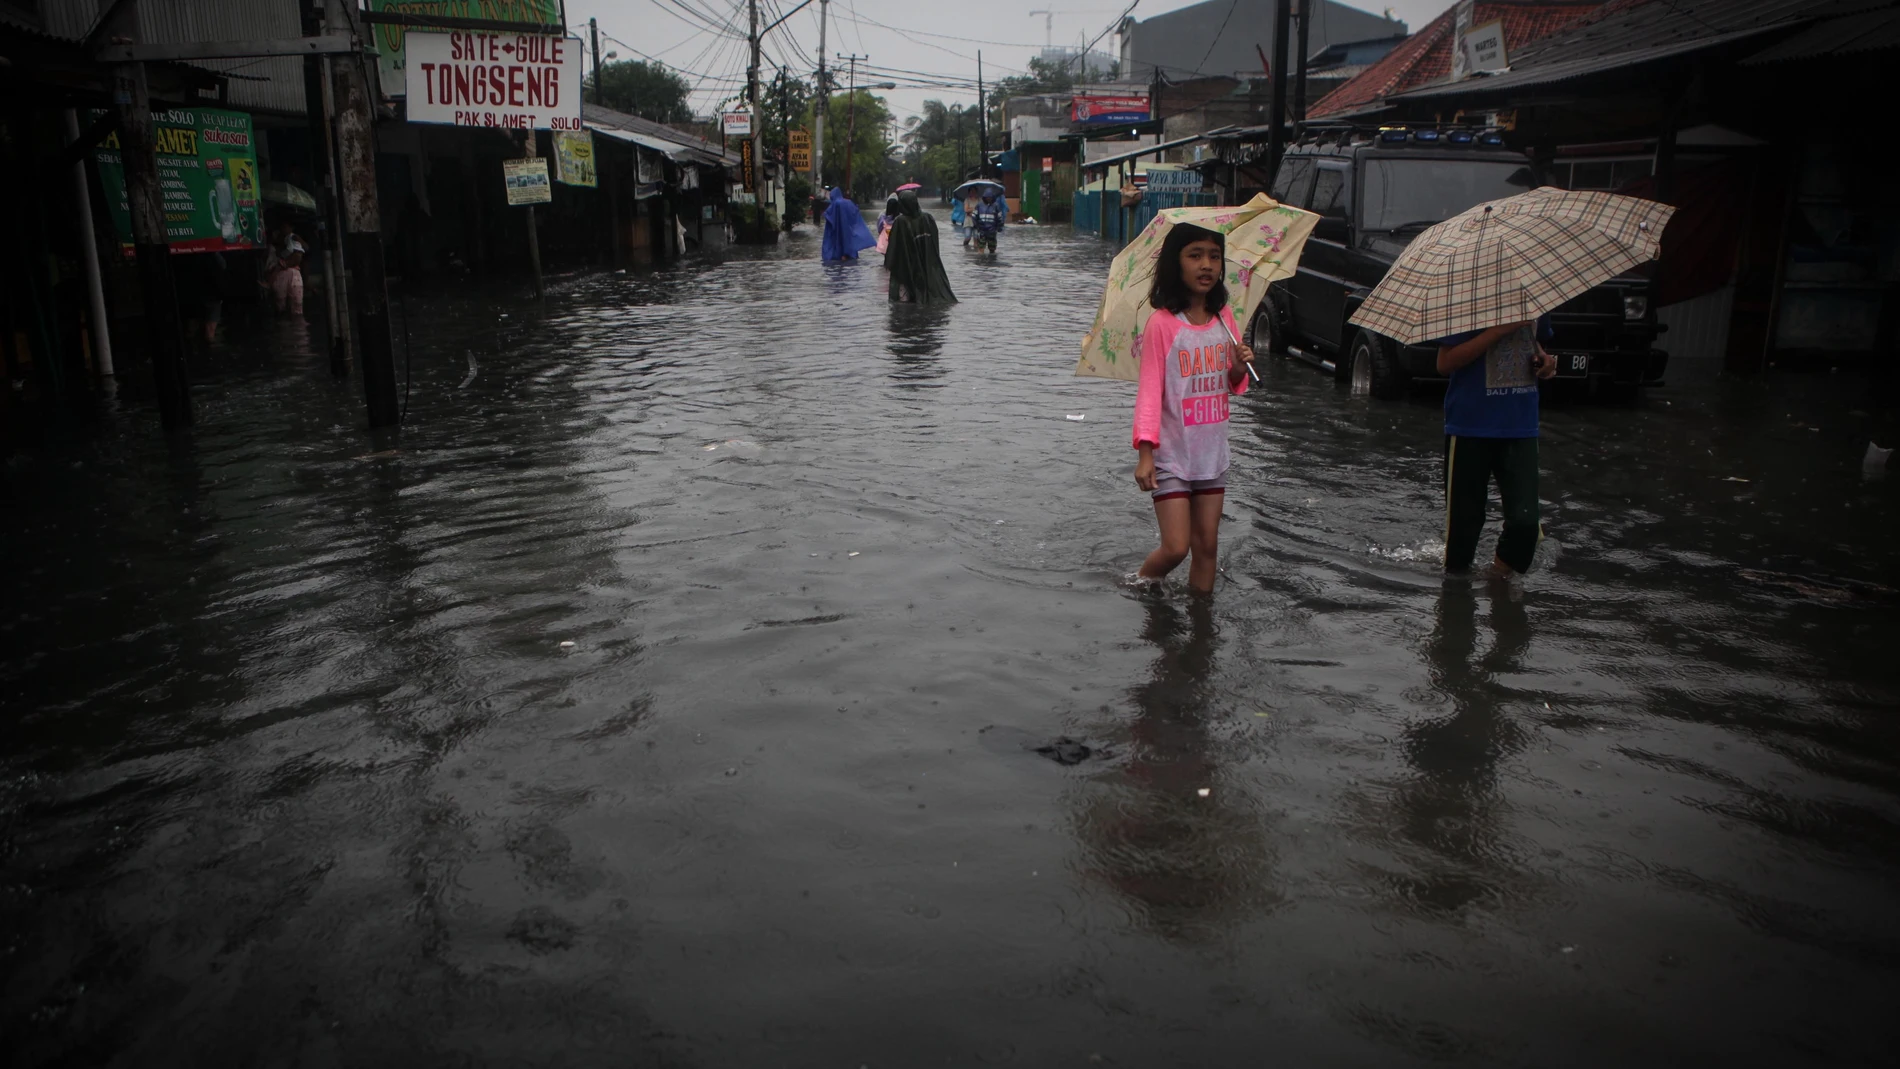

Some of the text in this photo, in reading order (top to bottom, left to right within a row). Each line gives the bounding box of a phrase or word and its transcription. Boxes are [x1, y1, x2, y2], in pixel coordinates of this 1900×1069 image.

[451, 31, 563, 64] SATE GULE
[421, 63, 559, 108] TONGSENG
[168, 109, 195, 125] SOLO
[455, 111, 580, 131] PAK SLAMET SOLO
[156, 127, 198, 155] AMET
[1192, 374, 1223, 393] LIKE A
[1194, 396, 1225, 423] GIRL
